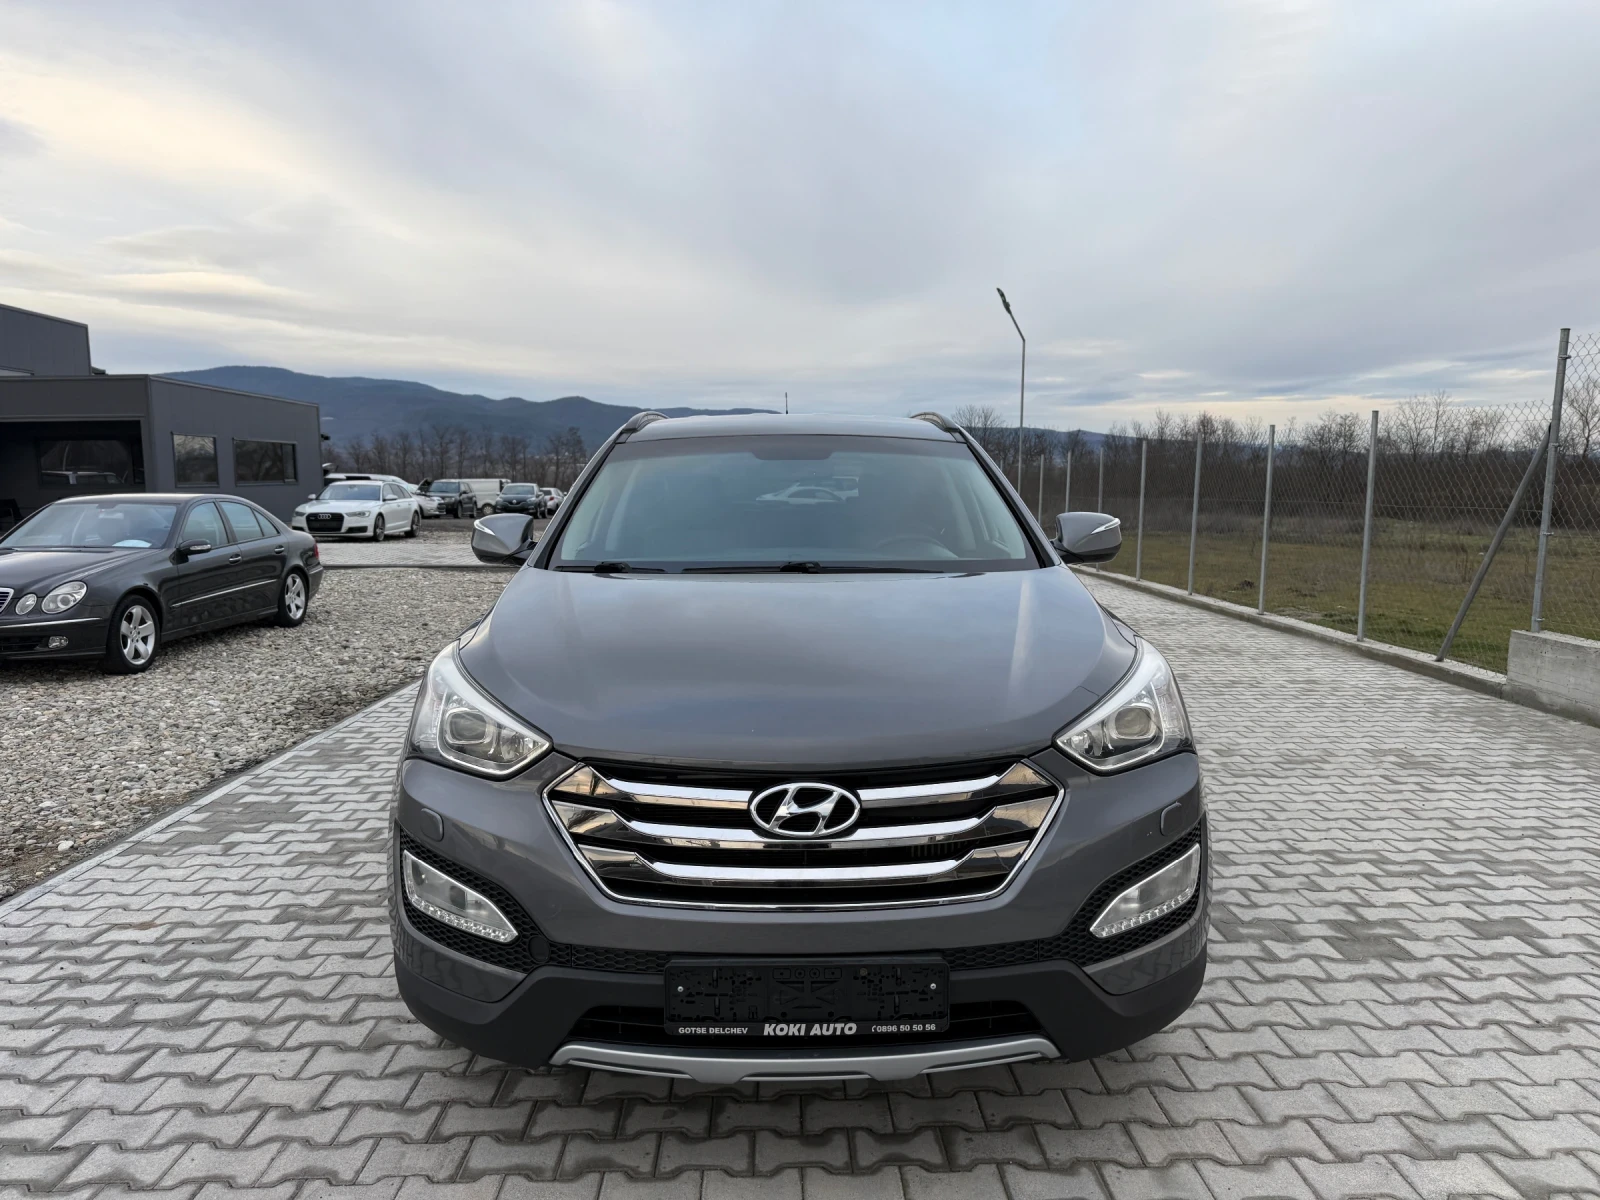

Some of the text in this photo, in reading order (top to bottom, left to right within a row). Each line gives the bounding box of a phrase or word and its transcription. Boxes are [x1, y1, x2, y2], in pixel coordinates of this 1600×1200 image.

[763, 1022, 857, 1036] KOKI AUTO
[876, 1025, 898, 1033] 0896
[899, 1024, 910, 1032] 50
[925, 1023, 936, 1031] 56
